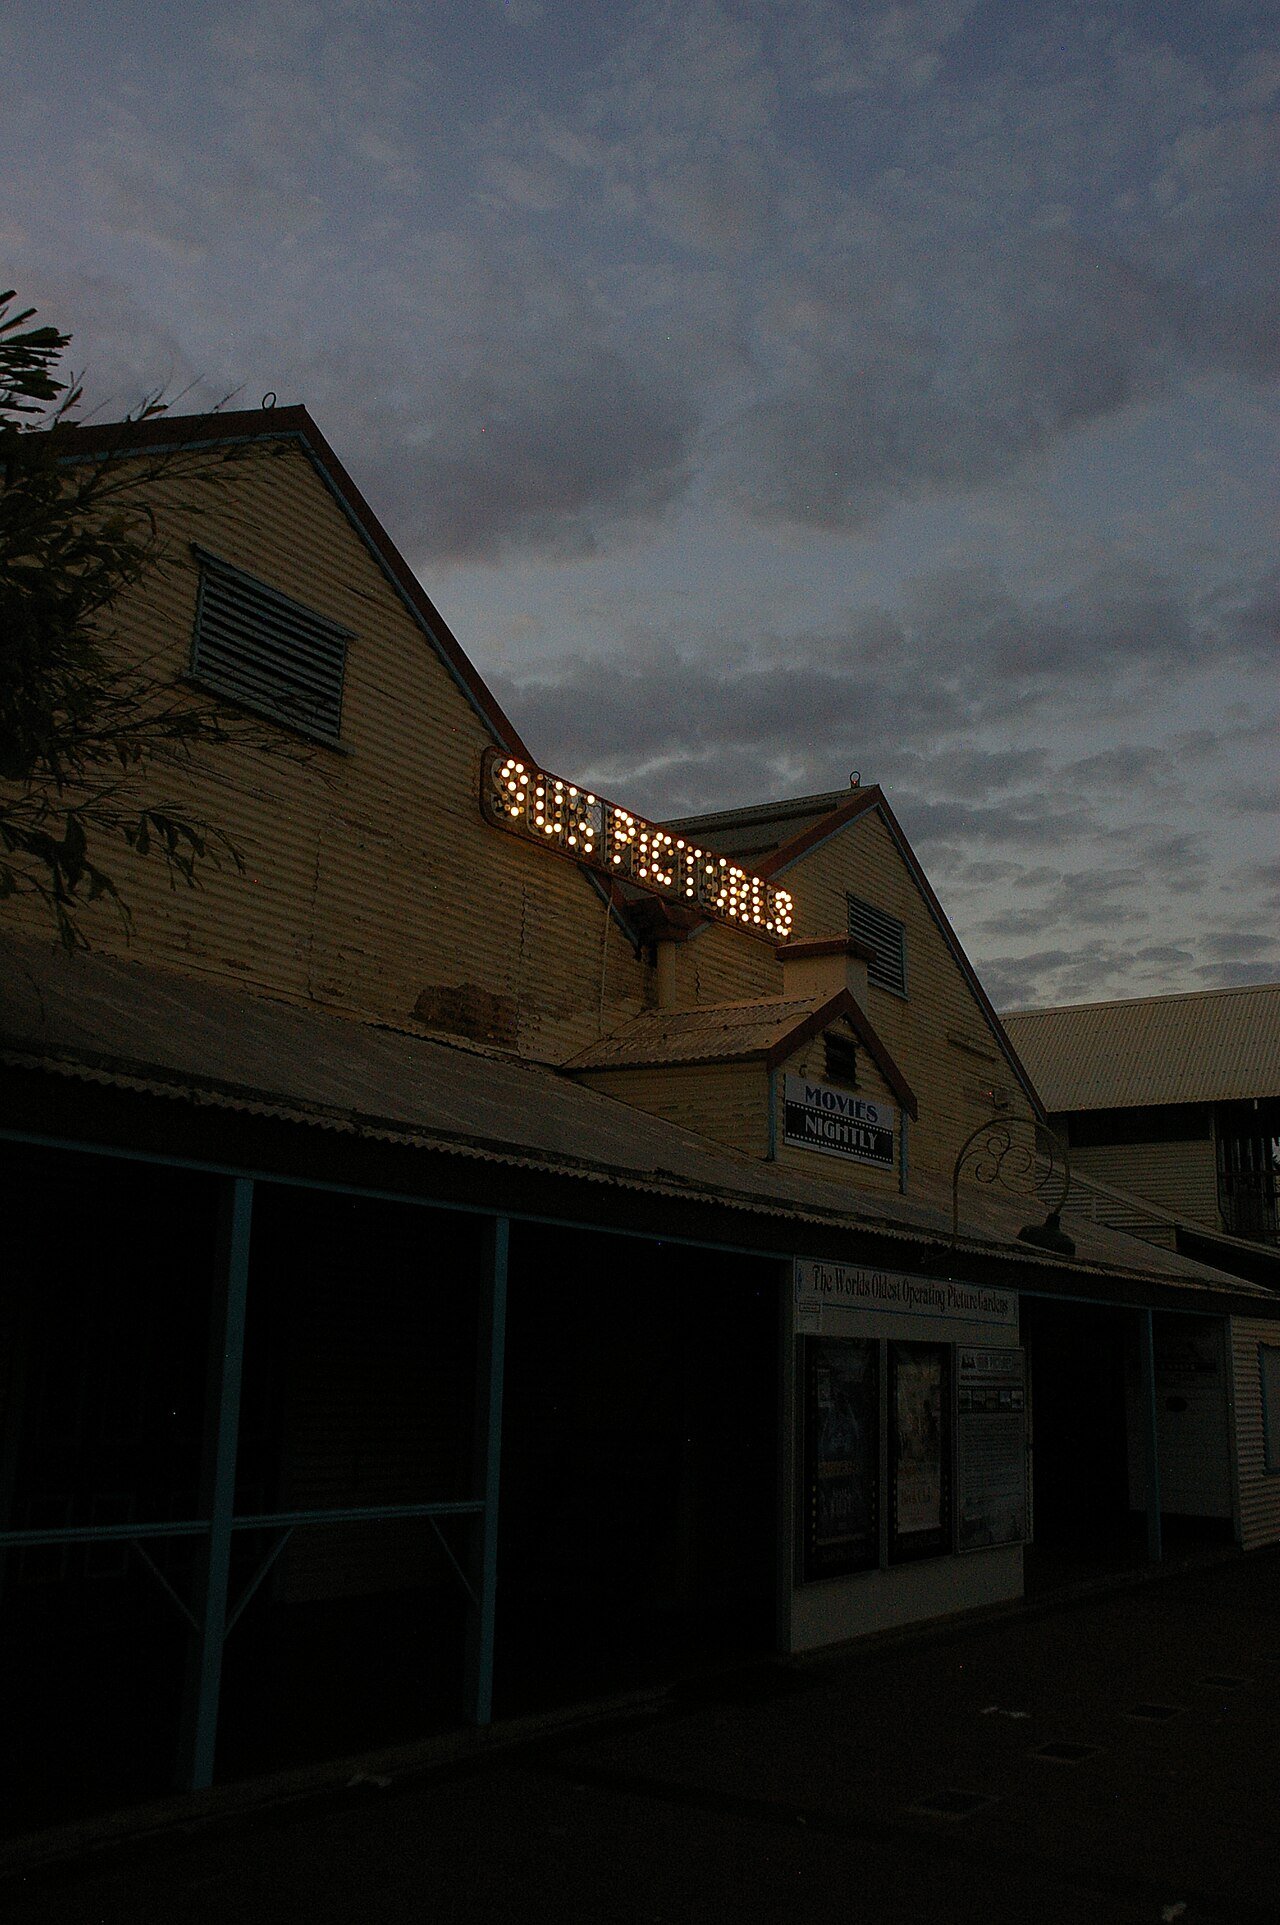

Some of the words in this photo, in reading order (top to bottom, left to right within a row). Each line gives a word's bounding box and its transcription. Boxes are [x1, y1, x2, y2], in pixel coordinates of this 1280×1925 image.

[491, 758, 597, 857] SUN
[605, 806, 793, 938] PICTURES
[805, 1085, 878, 1123] MOVIES
[805, 1114, 878, 1150] NIGHTLY
[813, 1264, 833, 1294] The
[835, 1267, 870, 1297] Worlds
[872, 1273, 901, 1301] Oldest
[902, 1277, 946, 1312] Operating
[947, 1284, 978, 1310] Picture
